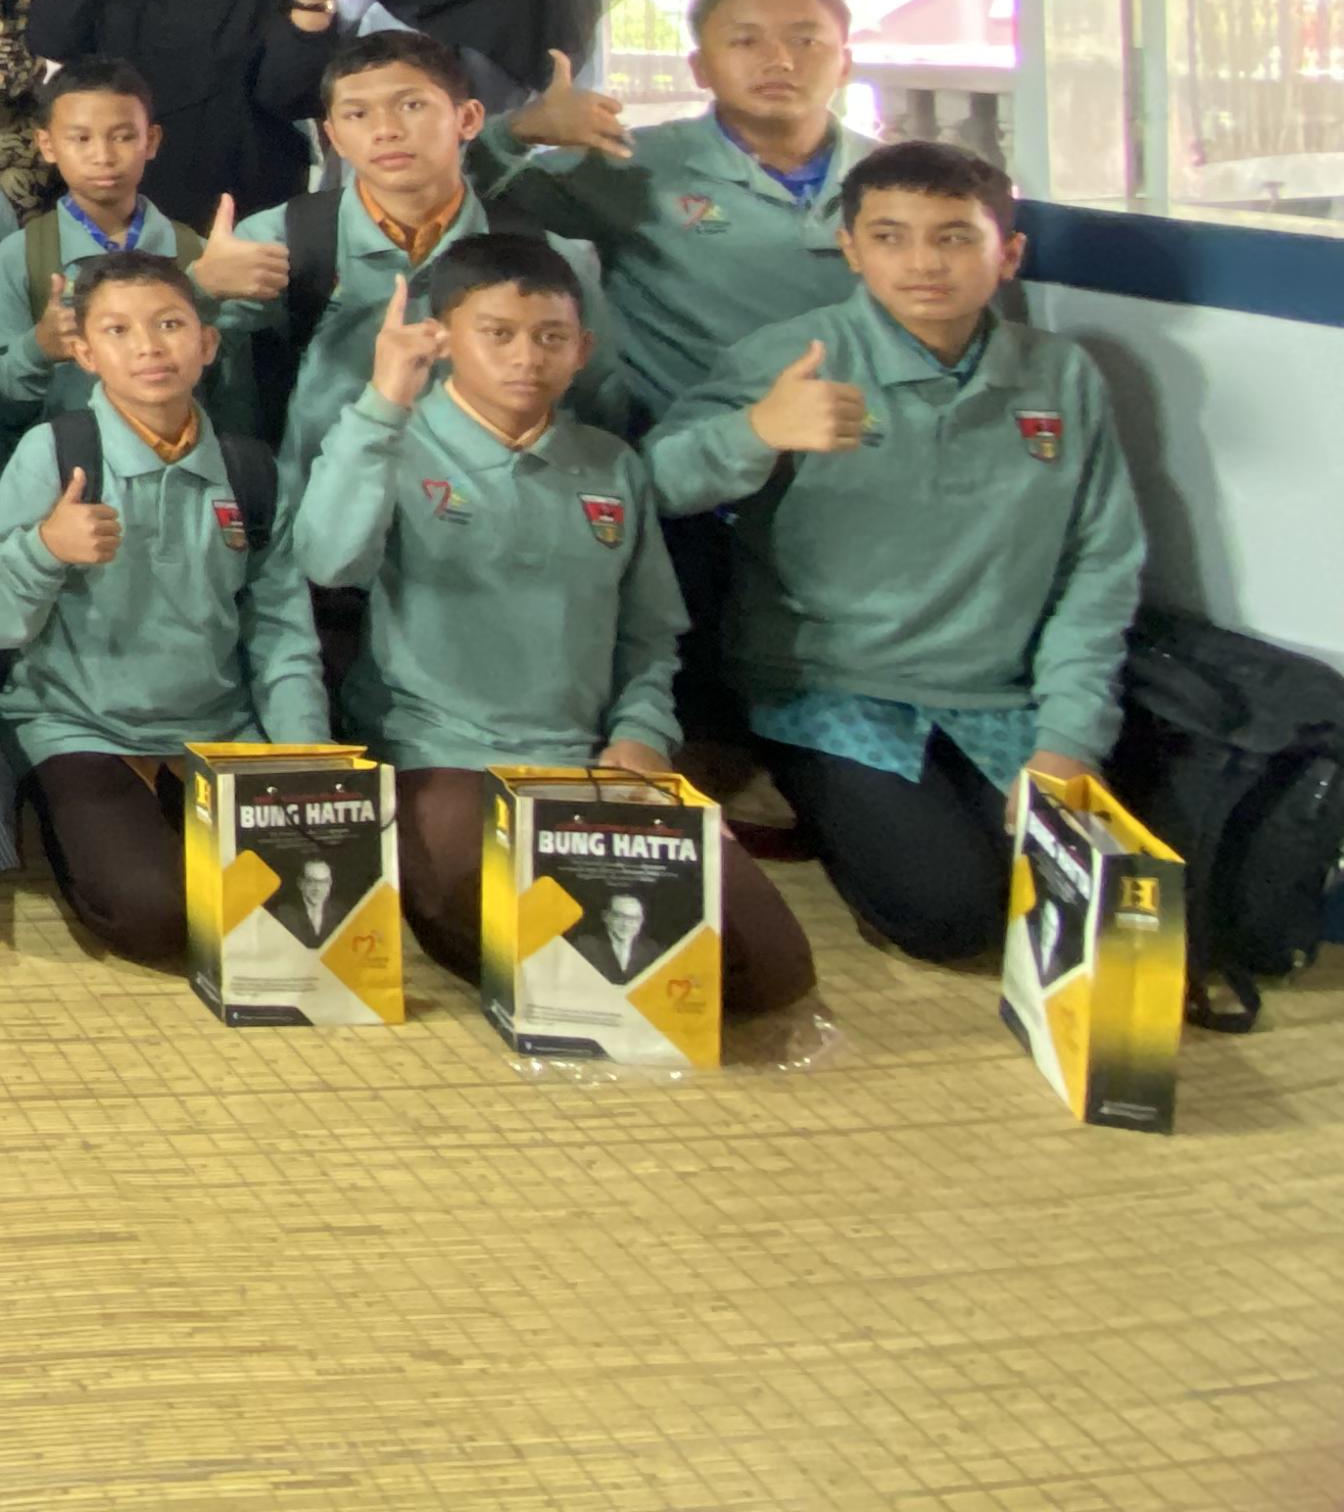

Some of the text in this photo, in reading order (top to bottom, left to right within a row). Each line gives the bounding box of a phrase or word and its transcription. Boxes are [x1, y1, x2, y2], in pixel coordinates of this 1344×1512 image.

[240, 799, 376, 829] BUNG HATTA
[538, 830, 697, 861] BUNG HATTA
